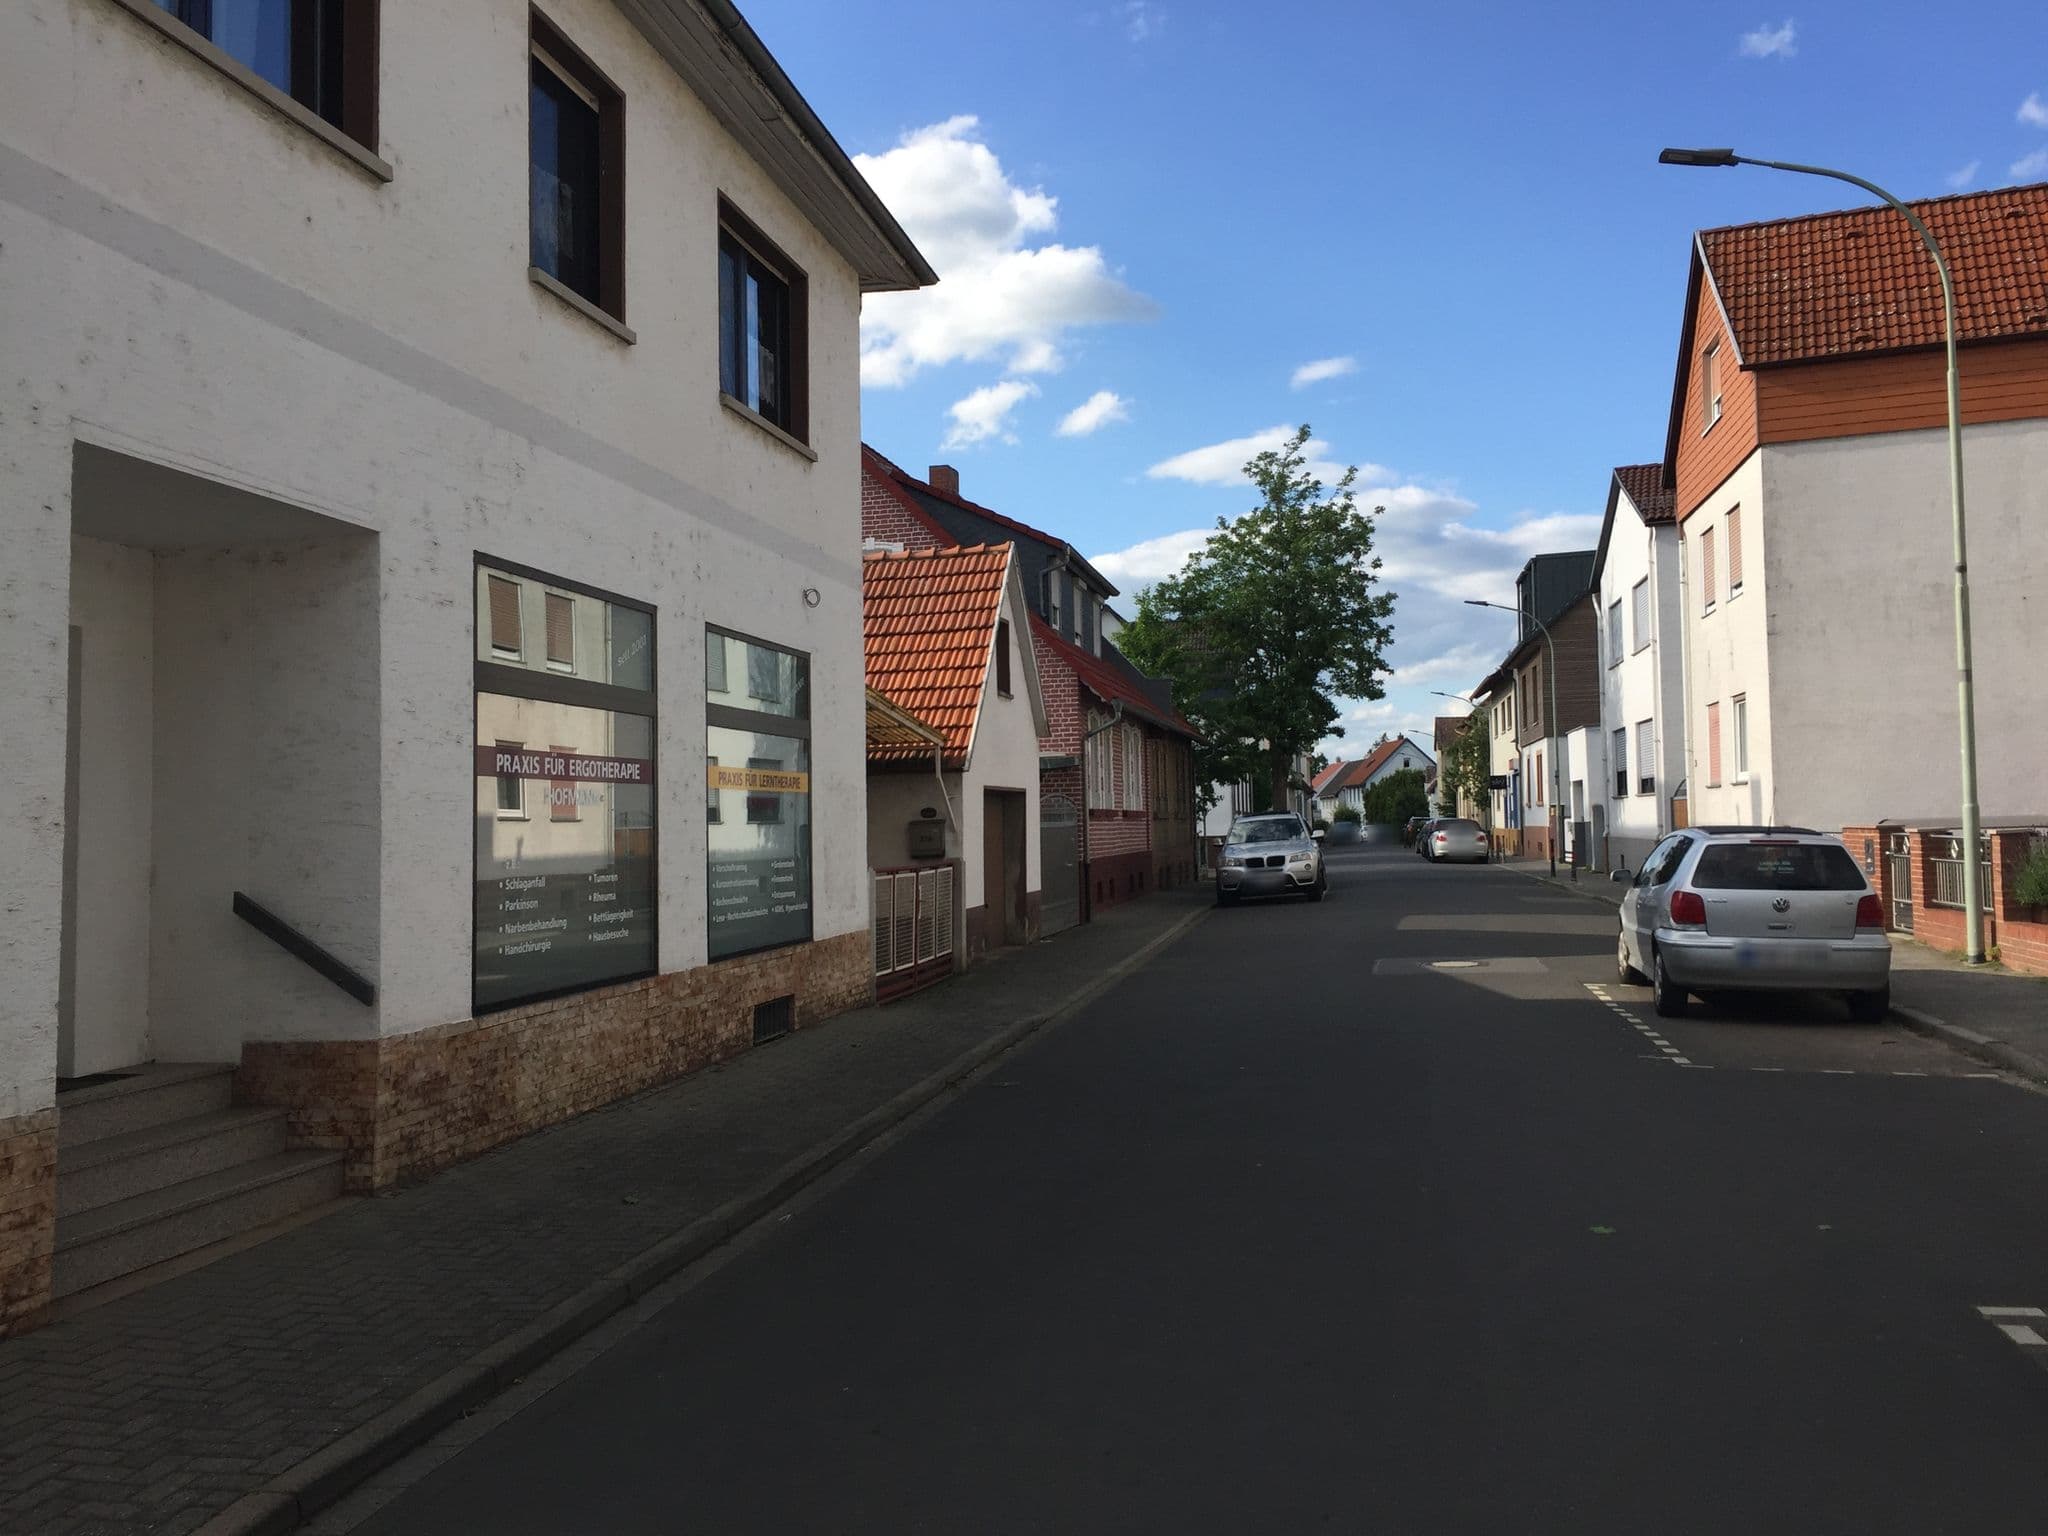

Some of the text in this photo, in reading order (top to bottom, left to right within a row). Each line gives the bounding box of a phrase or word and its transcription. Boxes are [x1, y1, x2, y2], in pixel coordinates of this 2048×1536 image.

[496, 752, 641, 780] PRAXIS FÜR ERGOTHERAPIE
[718, 769, 801, 790] PRAXIS FÜR LERNTHERAPIE
[505, 876, 546, 891] Schlaganfall
[504, 900, 539, 911] Parkinson
[504, 918, 568, 934] Narbenbehandlung
[504, 939, 552, 956] Handchirurgie
